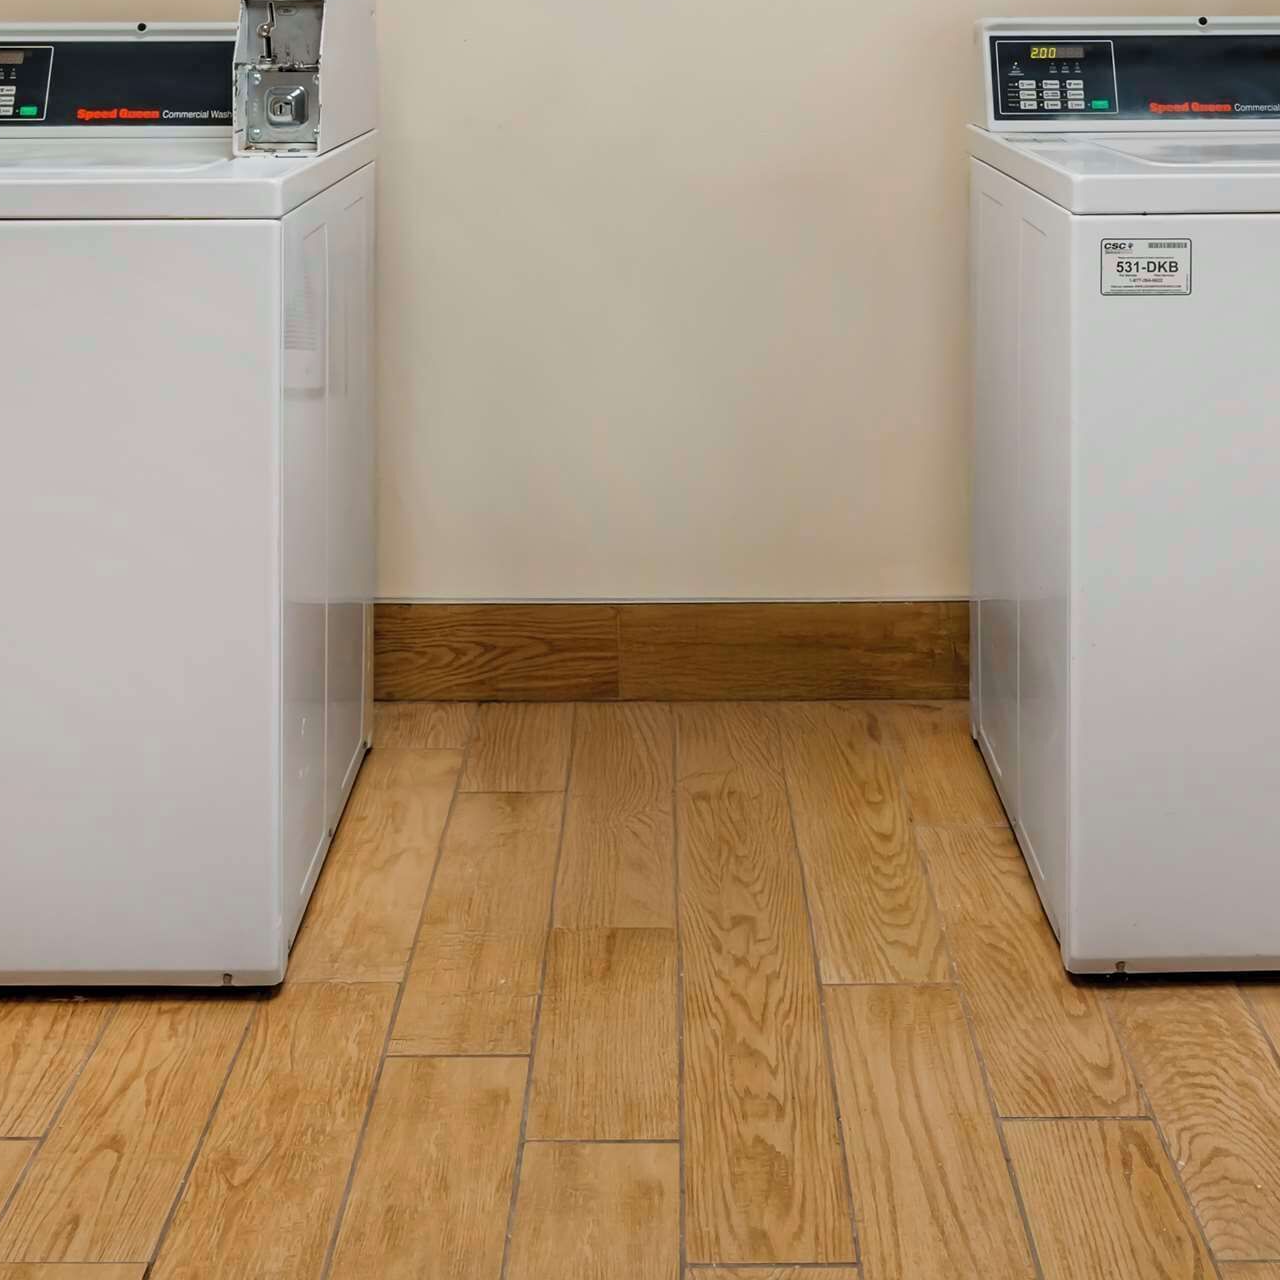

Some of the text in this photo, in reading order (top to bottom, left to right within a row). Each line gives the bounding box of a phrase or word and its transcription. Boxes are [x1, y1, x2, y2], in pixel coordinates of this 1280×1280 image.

[1149, 102, 1189, 113] Speed
[1191, 102, 1232, 112] Queen
[1234, 103, 1280, 112] Commercial
[77, 109, 232, 120] Speed Queen Commercial Wash
[1116, 261, 1179, 273] 531-DKB
